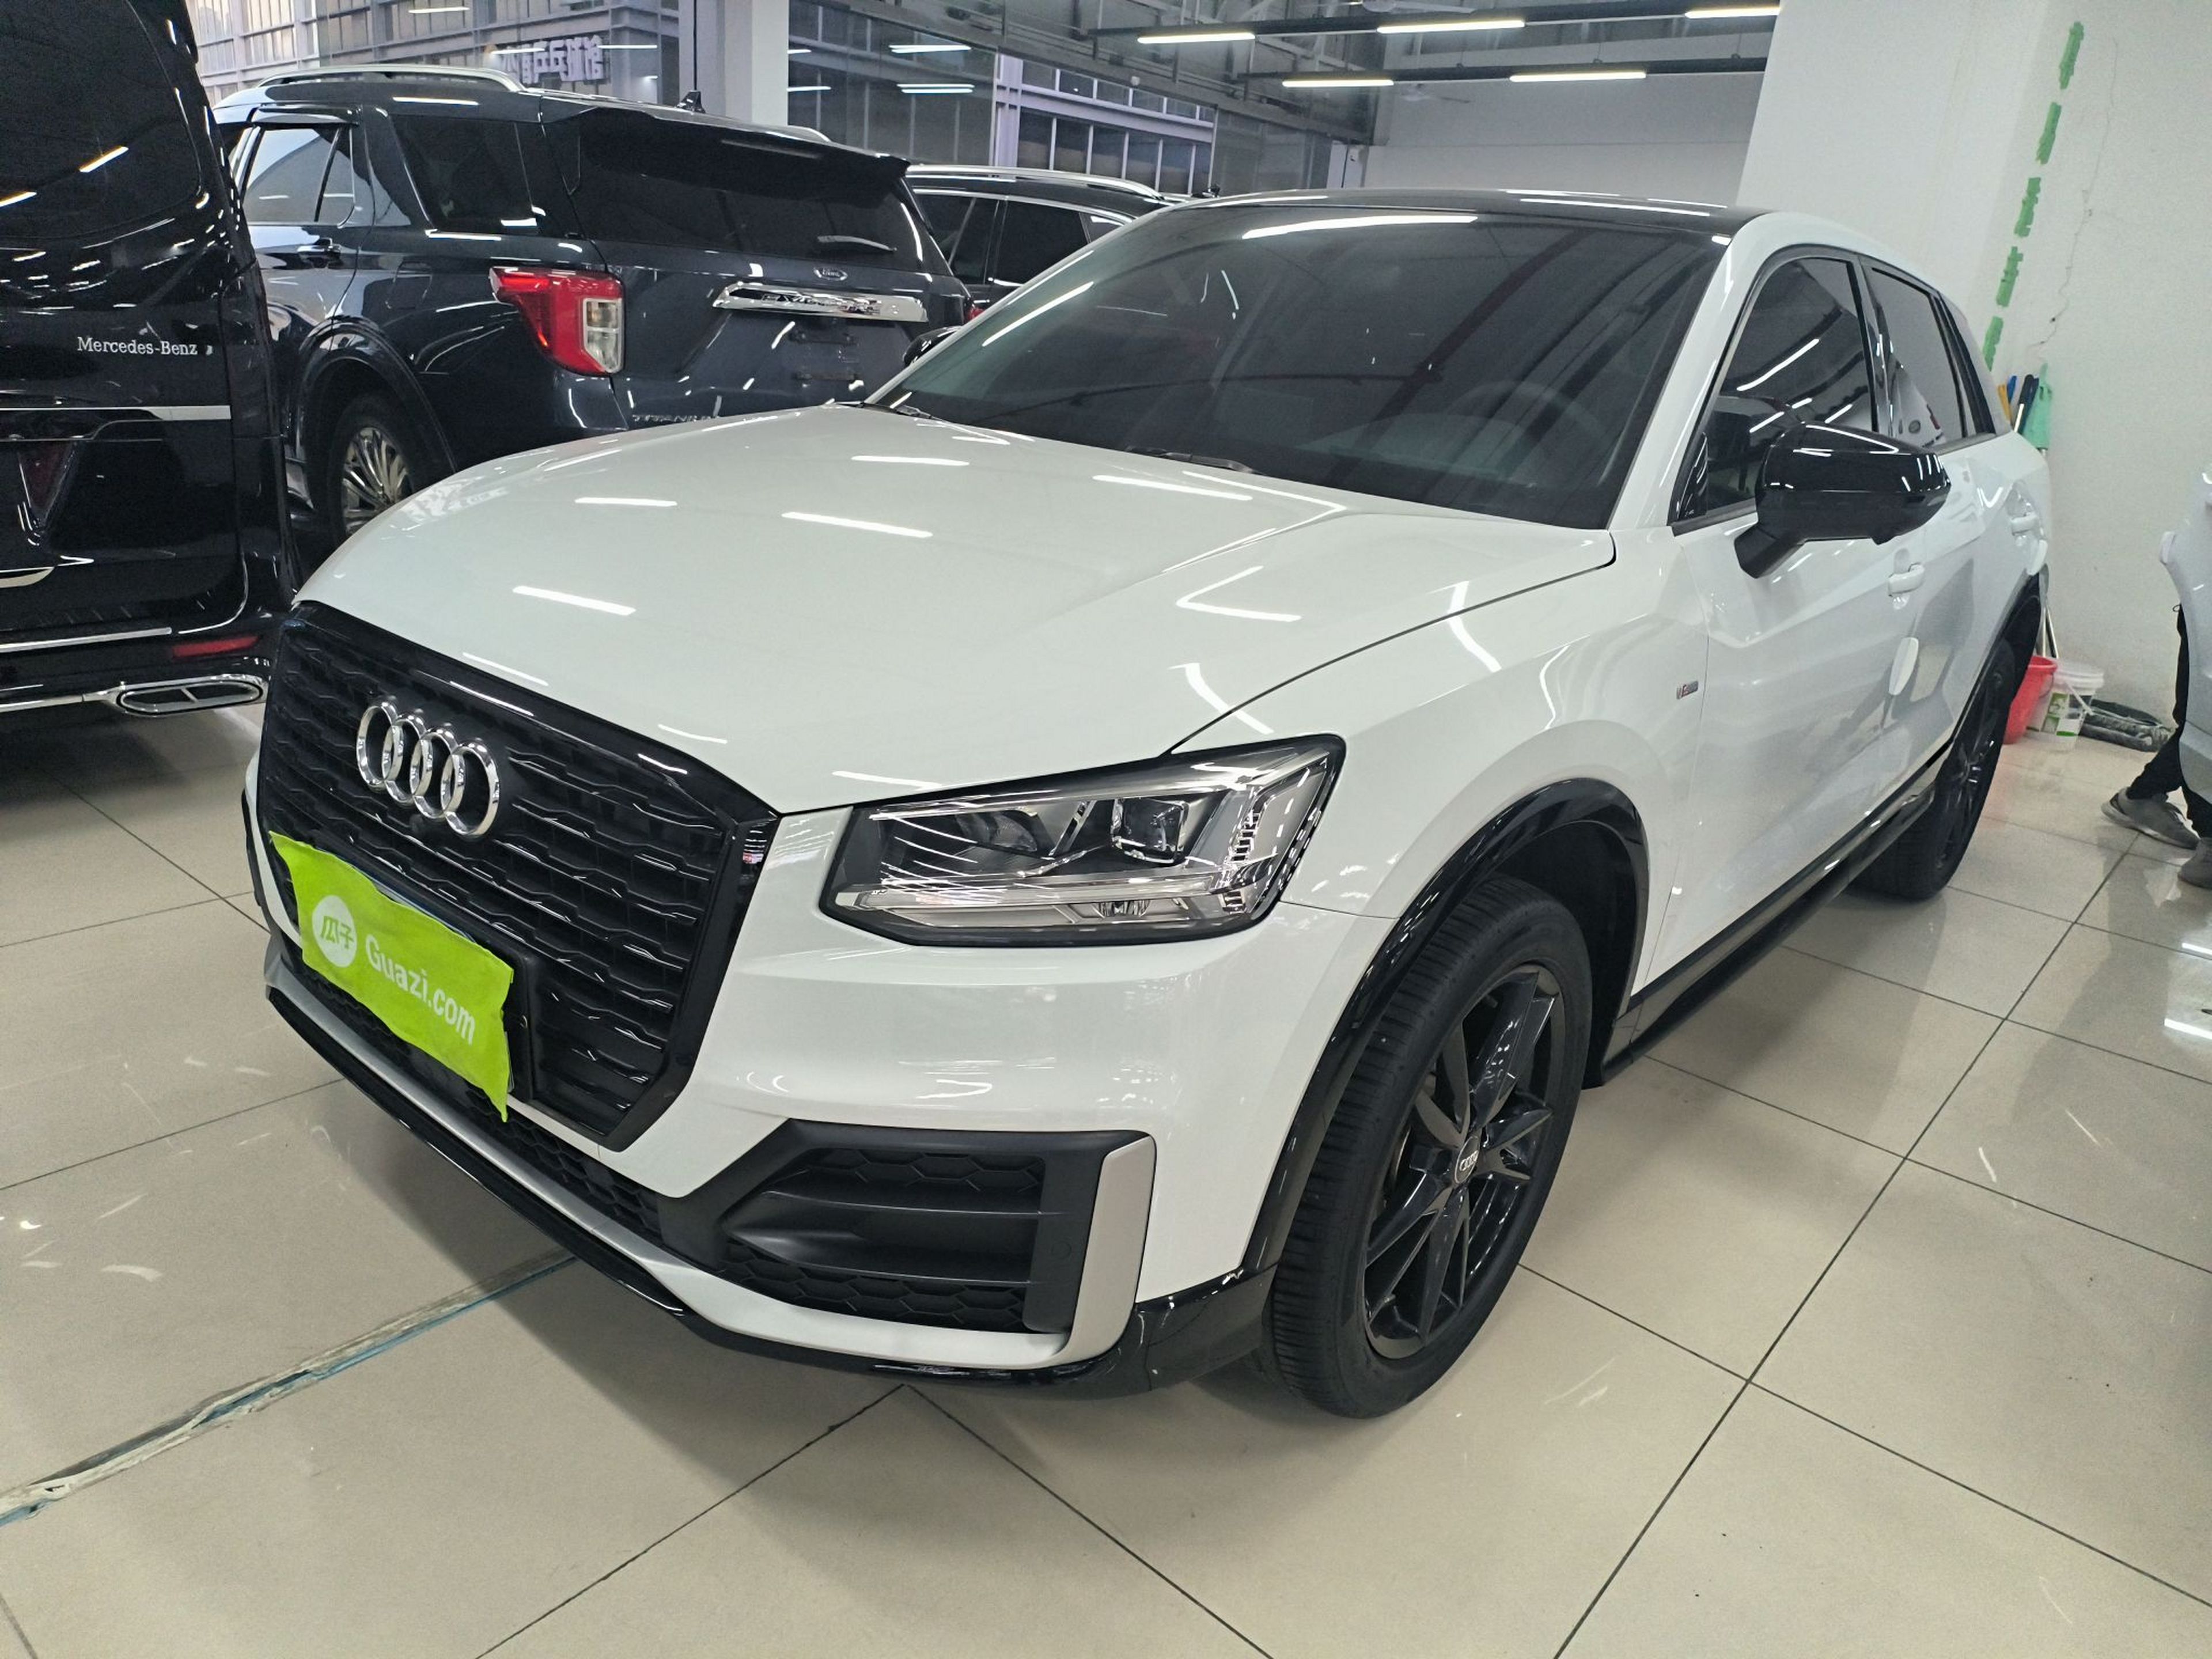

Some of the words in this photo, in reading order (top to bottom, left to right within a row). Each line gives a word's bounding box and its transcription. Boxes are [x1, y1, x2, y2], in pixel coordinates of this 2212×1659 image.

[77, 336, 198, 355] Mercedes-Benz
[320, 915, 354, 949] 瓜子
[365, 934, 475, 1046] Guazi.com
